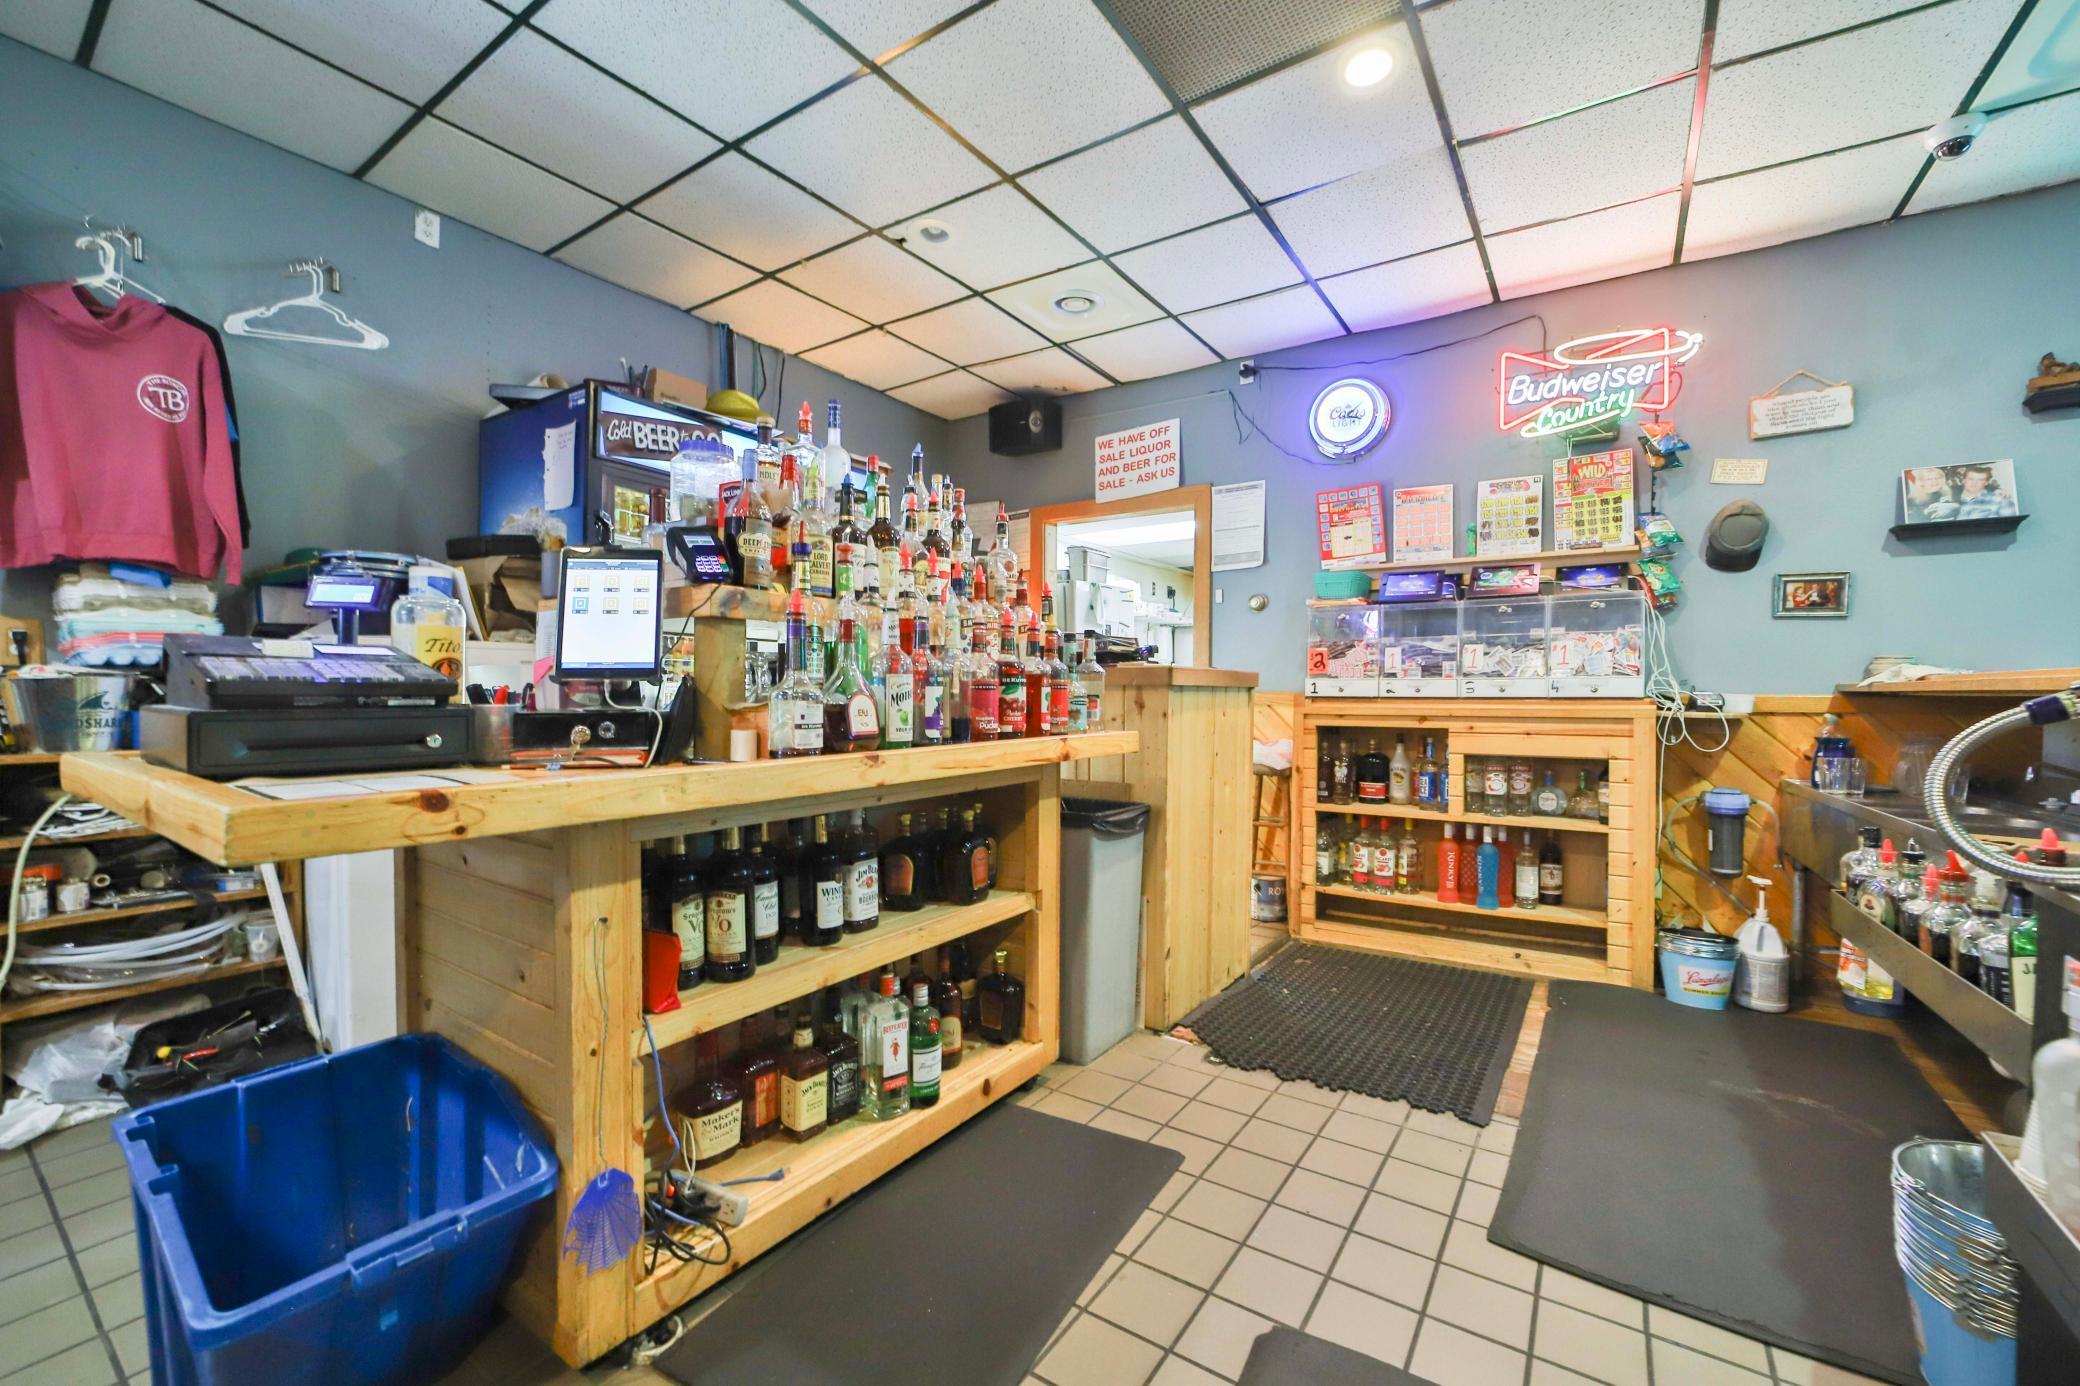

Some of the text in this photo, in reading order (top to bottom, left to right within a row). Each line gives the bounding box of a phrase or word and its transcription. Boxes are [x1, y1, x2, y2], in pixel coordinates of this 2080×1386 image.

[1507, 361, 1663, 406] Budweiser
[147, 386, 185, 411] TB
[1535, 388, 1636, 432] Country
[607, 419, 632, 441] Cold
[633, 421, 680, 452] BEER
[1098, 425, 1171, 450] WE HAVE OFF
[1099, 439, 1172, 464] SALE LIQUOR
[1098, 452, 1177, 478] AND BEER FOR
[1578, 463, 1607, 479] WILD
[1098, 478, 1126, 491] SALE
[1136, 472, 1159, 484] ASK
[1160, 466, 1176, 478] US
[813, 553, 829, 561] LORD
[1310, 682, 1319, 694] 1
[882, 1021, 908, 1034] BEEFEATER
[701, 1106, 741, 1128] Maker's
[713, 1116, 739, 1133] Mark
